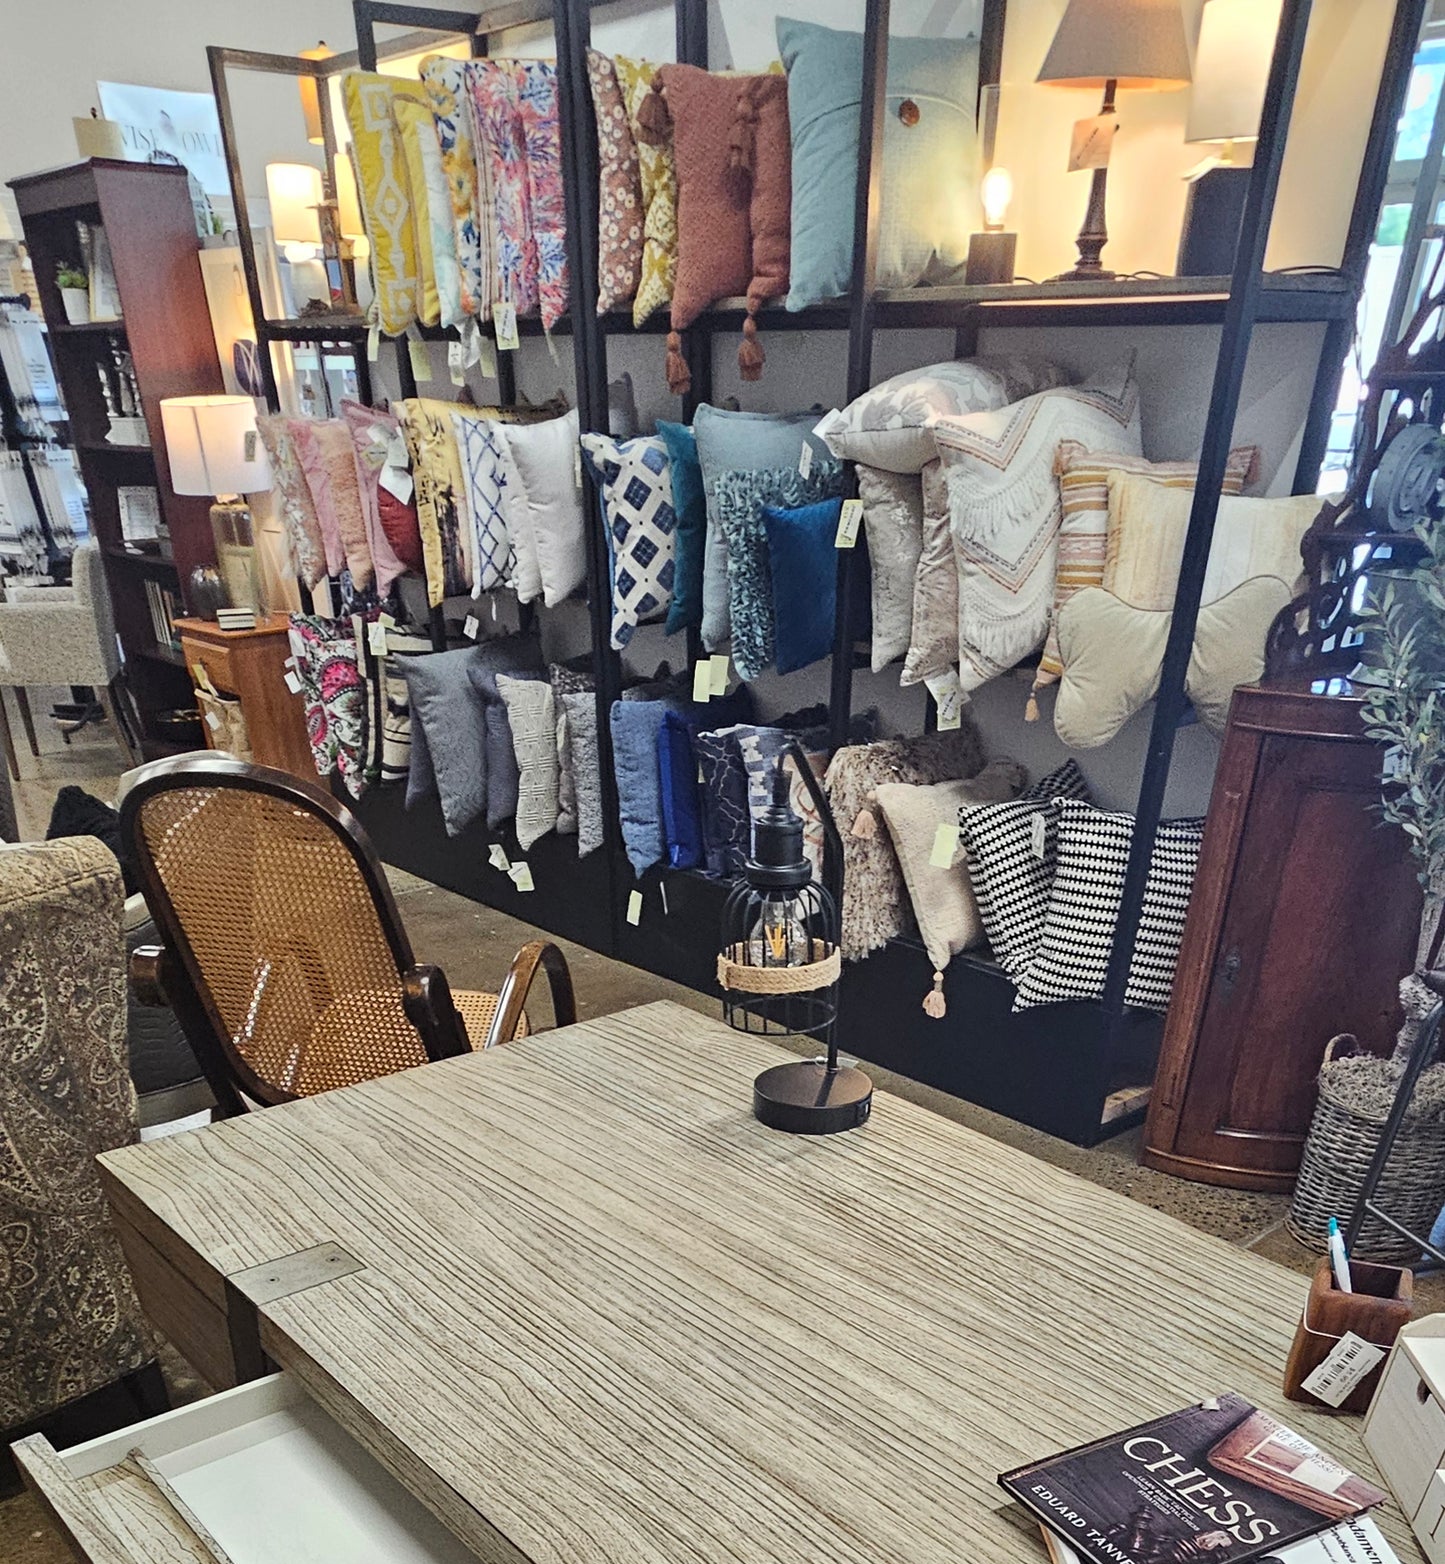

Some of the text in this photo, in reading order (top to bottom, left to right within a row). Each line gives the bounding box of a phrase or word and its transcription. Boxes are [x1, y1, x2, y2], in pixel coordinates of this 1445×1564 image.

[1260, 1414, 1294, 1438] MASTER
[1293, 1438, 1311, 1451] THE
[1263, 1425, 1287, 1442] GAME
[1288, 1442, 1301, 1451] OF
[1123, 1436, 1280, 1545] CHESS
[1137, 1475, 1156, 1490] LEARN
[1031, 1484, 1087, 1529] EDUARD
